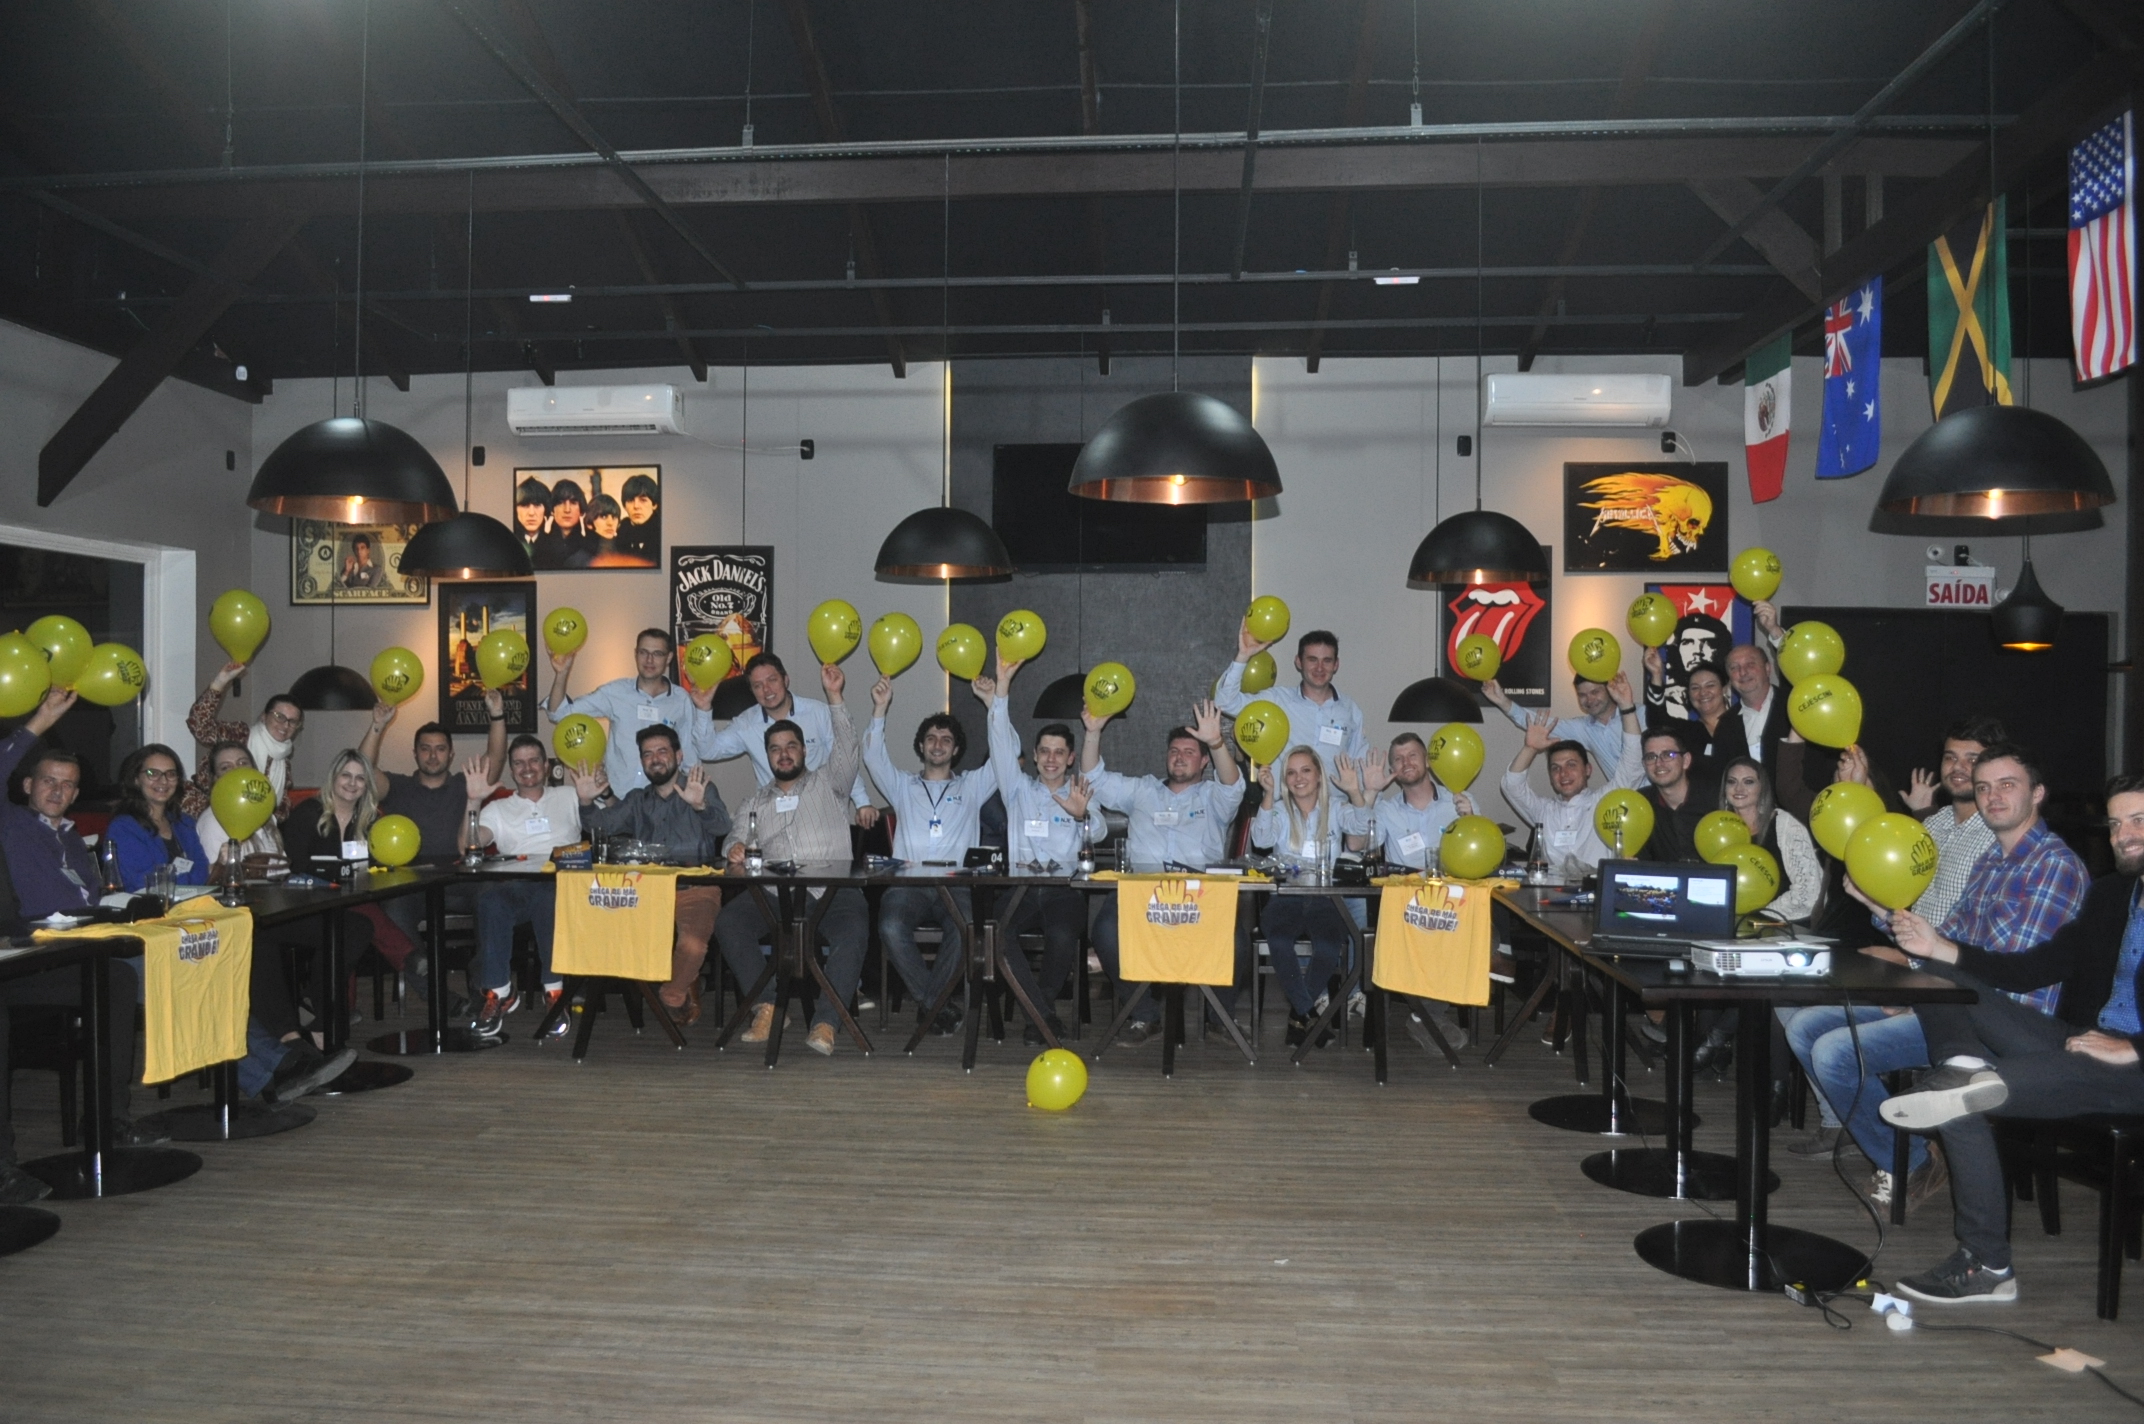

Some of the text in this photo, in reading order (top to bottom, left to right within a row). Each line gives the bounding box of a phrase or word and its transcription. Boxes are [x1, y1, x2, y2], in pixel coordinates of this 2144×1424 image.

[678, 559, 766, 592] JACK DANIEL'S
[333, 589, 389, 598] SCARFACE
[1928, 579, 1989, 604] SAÍDA
[712, 594, 731, 602] Old
[991, 852, 1003, 863] 04
[340, 865, 351, 877] 06
[1365, 865, 1374, 877] 03
[588, 895, 638, 907] GRANDE!
[1183, 903, 1198, 911] MÃO
[1146, 911, 1201, 923] GRANDE!
[1406, 904, 1429, 914] CHEGA
[1442, 910, 1458, 919] MÃO
[1403, 912, 1459, 932] GRANDE!
[178, 940, 219, 960] GRANDE!
